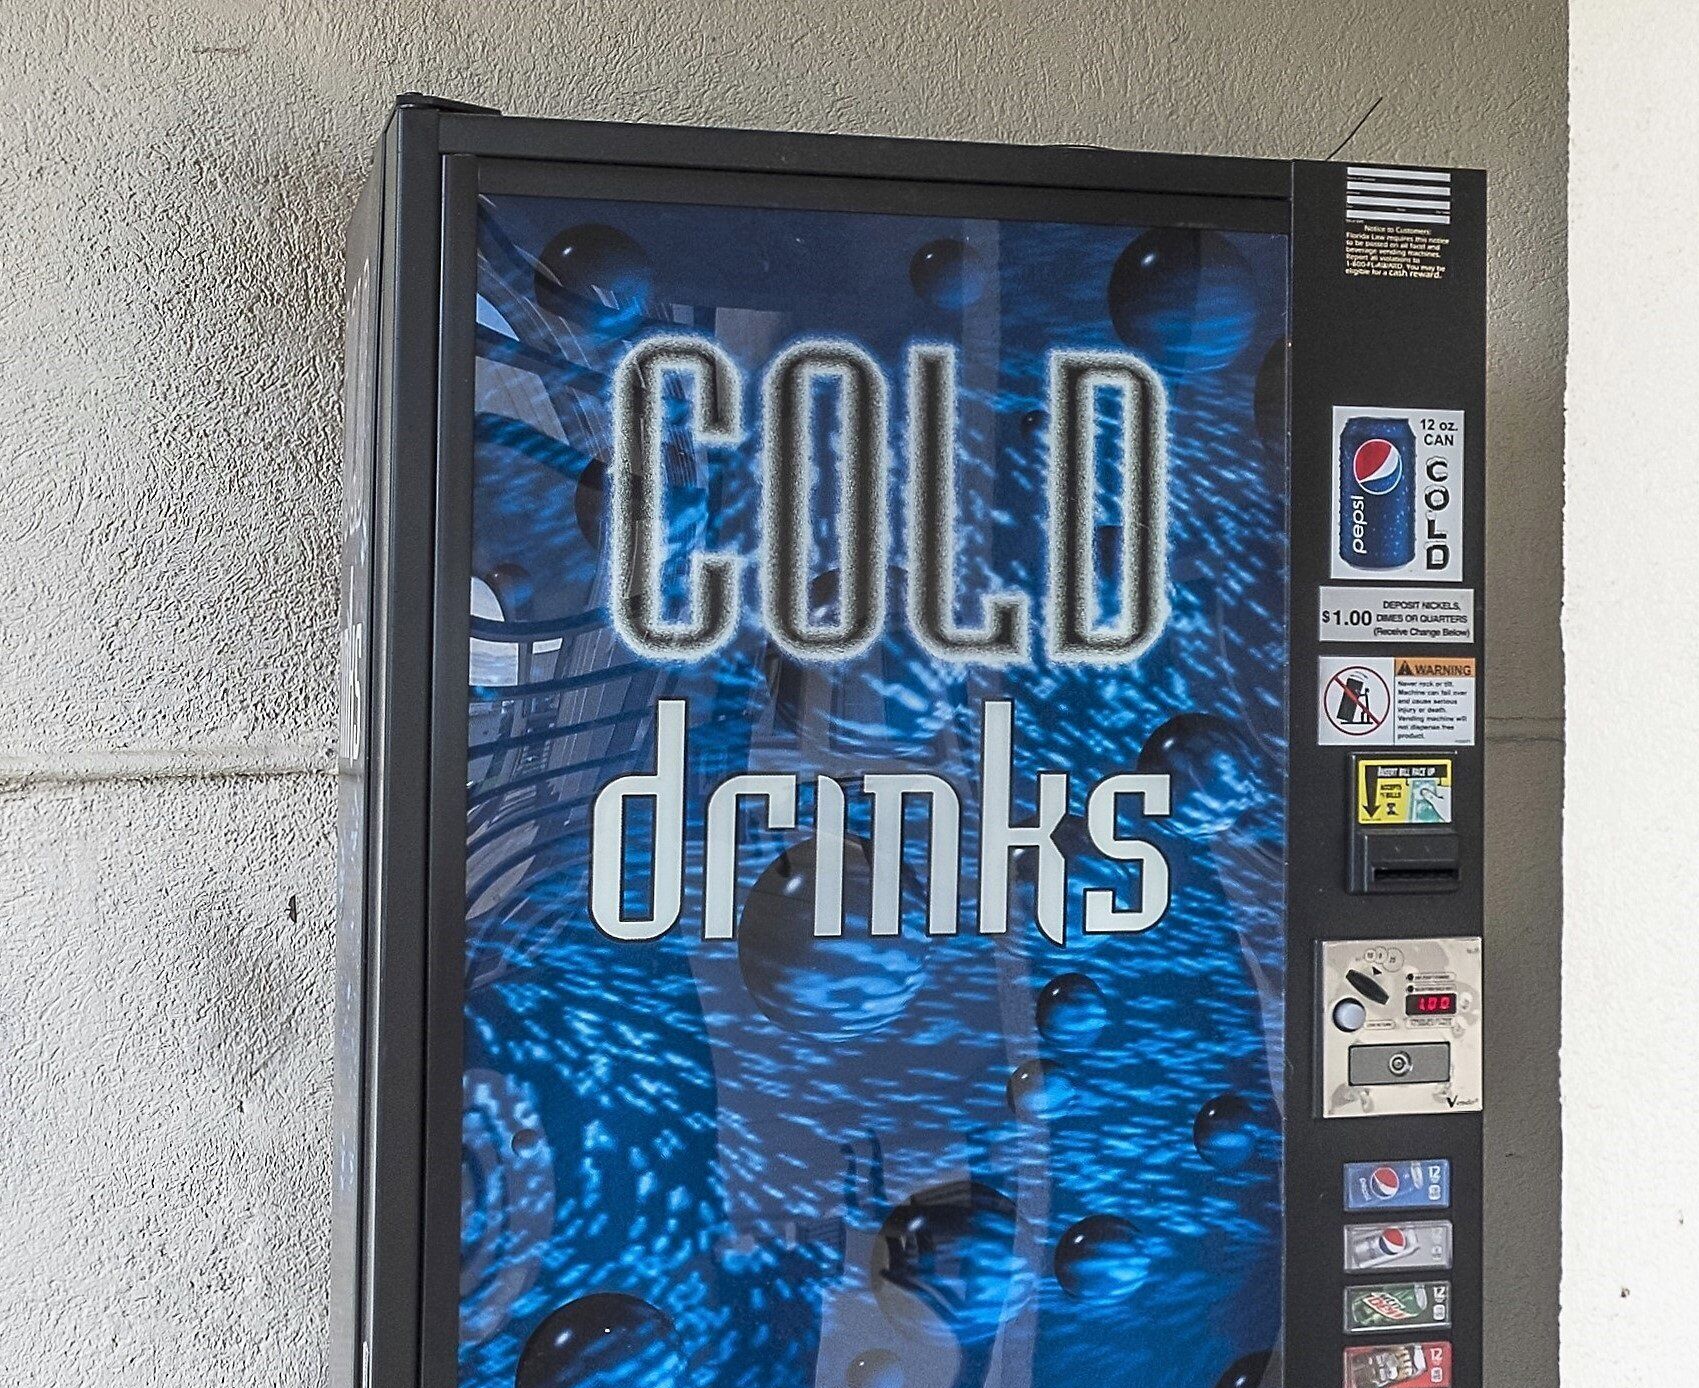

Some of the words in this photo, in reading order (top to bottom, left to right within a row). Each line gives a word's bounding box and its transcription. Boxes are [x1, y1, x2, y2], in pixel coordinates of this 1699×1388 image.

[1346, 246, 1377, 254] beverage
[1410, 242, 1425, 250] food
[1421, 419, 1435, 431] 12
[1439, 420, 1458, 431] oz.
[1424, 433, 1454, 446] CAN
[608, 332, 1174, 666] COLD
[1424, 456, 1450, 570] COLD
[1351, 495, 1367, 555] pepsi
[1383, 600, 1420, 609] DEPOSIT
[1322, 610, 1372, 626] $1.00
[1376, 614, 1403, 622] DIMES
[1405, 614, 1418, 622] OR
[1420, 614, 1468, 623] QUARTERS
[1374, 627, 1408, 636] (Receive
[1410, 627, 1441, 638] Change
[1442, 628, 1470, 638] Below)
[1415, 664, 1471, 676] WARNING
[1398, 715, 1424, 723] Vending
[1378, 766, 1398, 777] INSERT
[1399, 767, 1410, 776] BILL
[1412, 767, 1426, 776] FACE
[1427, 767, 1435, 776] UP
[590, 697, 1172, 945] drinks
[1433, 1286, 1446, 1298] 12
[1430, 1348, 1442, 1360] 12
